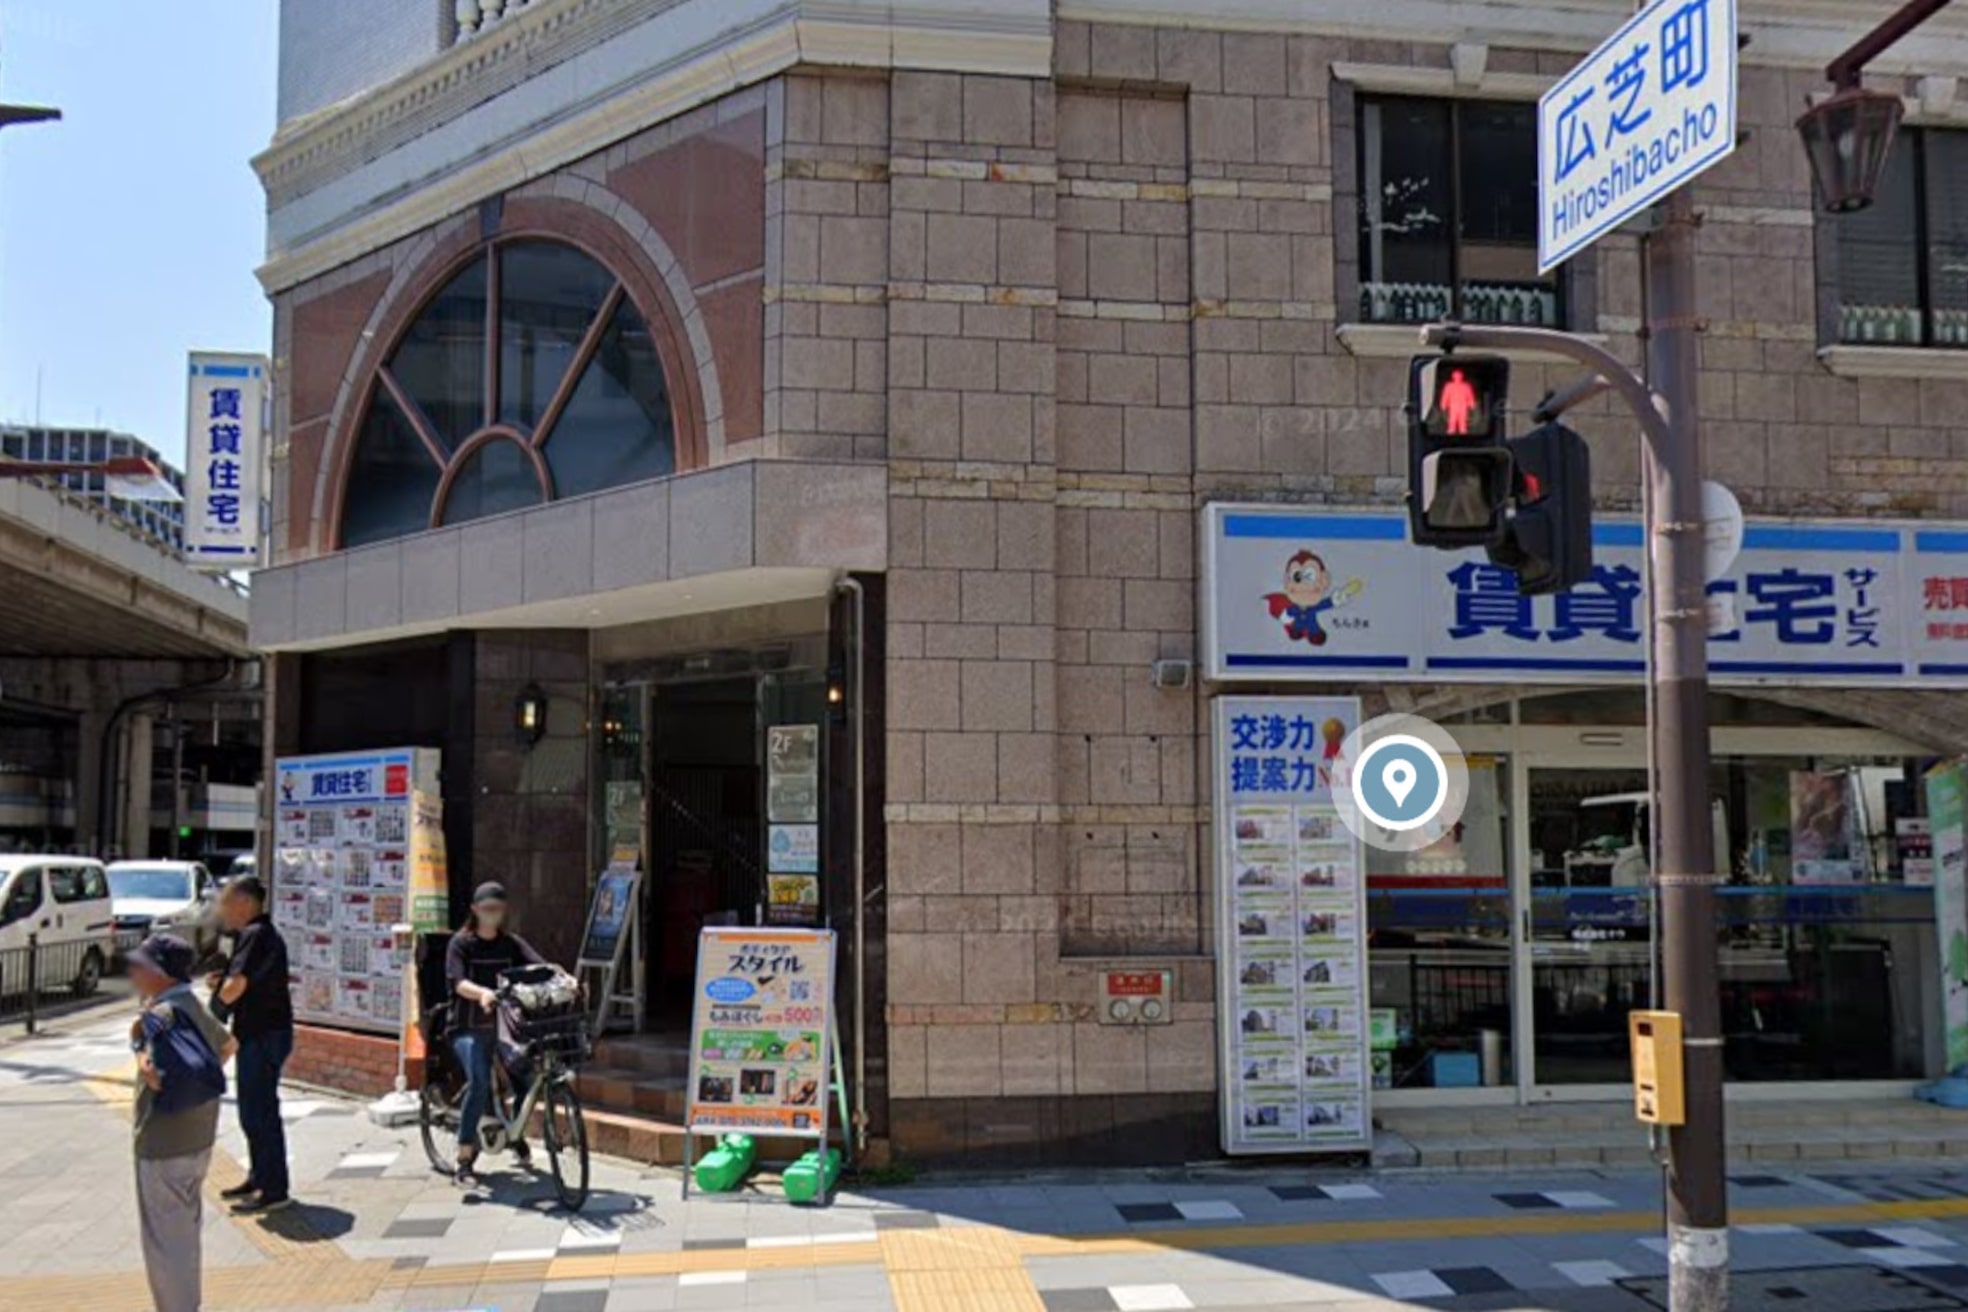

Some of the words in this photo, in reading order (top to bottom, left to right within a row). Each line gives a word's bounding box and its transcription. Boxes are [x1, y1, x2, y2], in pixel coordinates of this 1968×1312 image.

[1554, 0, 1709, 186] 広芝町
[1552, 102, 1718, 240] Hiroshibacho
[207, 387, 242, 526] 賃貸住宅
[1446, 560, 1838, 644] 賃貸宅
[1843, 567, 1879, 648] サービス
[771, 733, 792, 754] 2F
[1230, 714, 1315, 751] 交渉力
[1230, 757, 1315, 793] 提案力
[728, 954, 805, 974] スタイル
